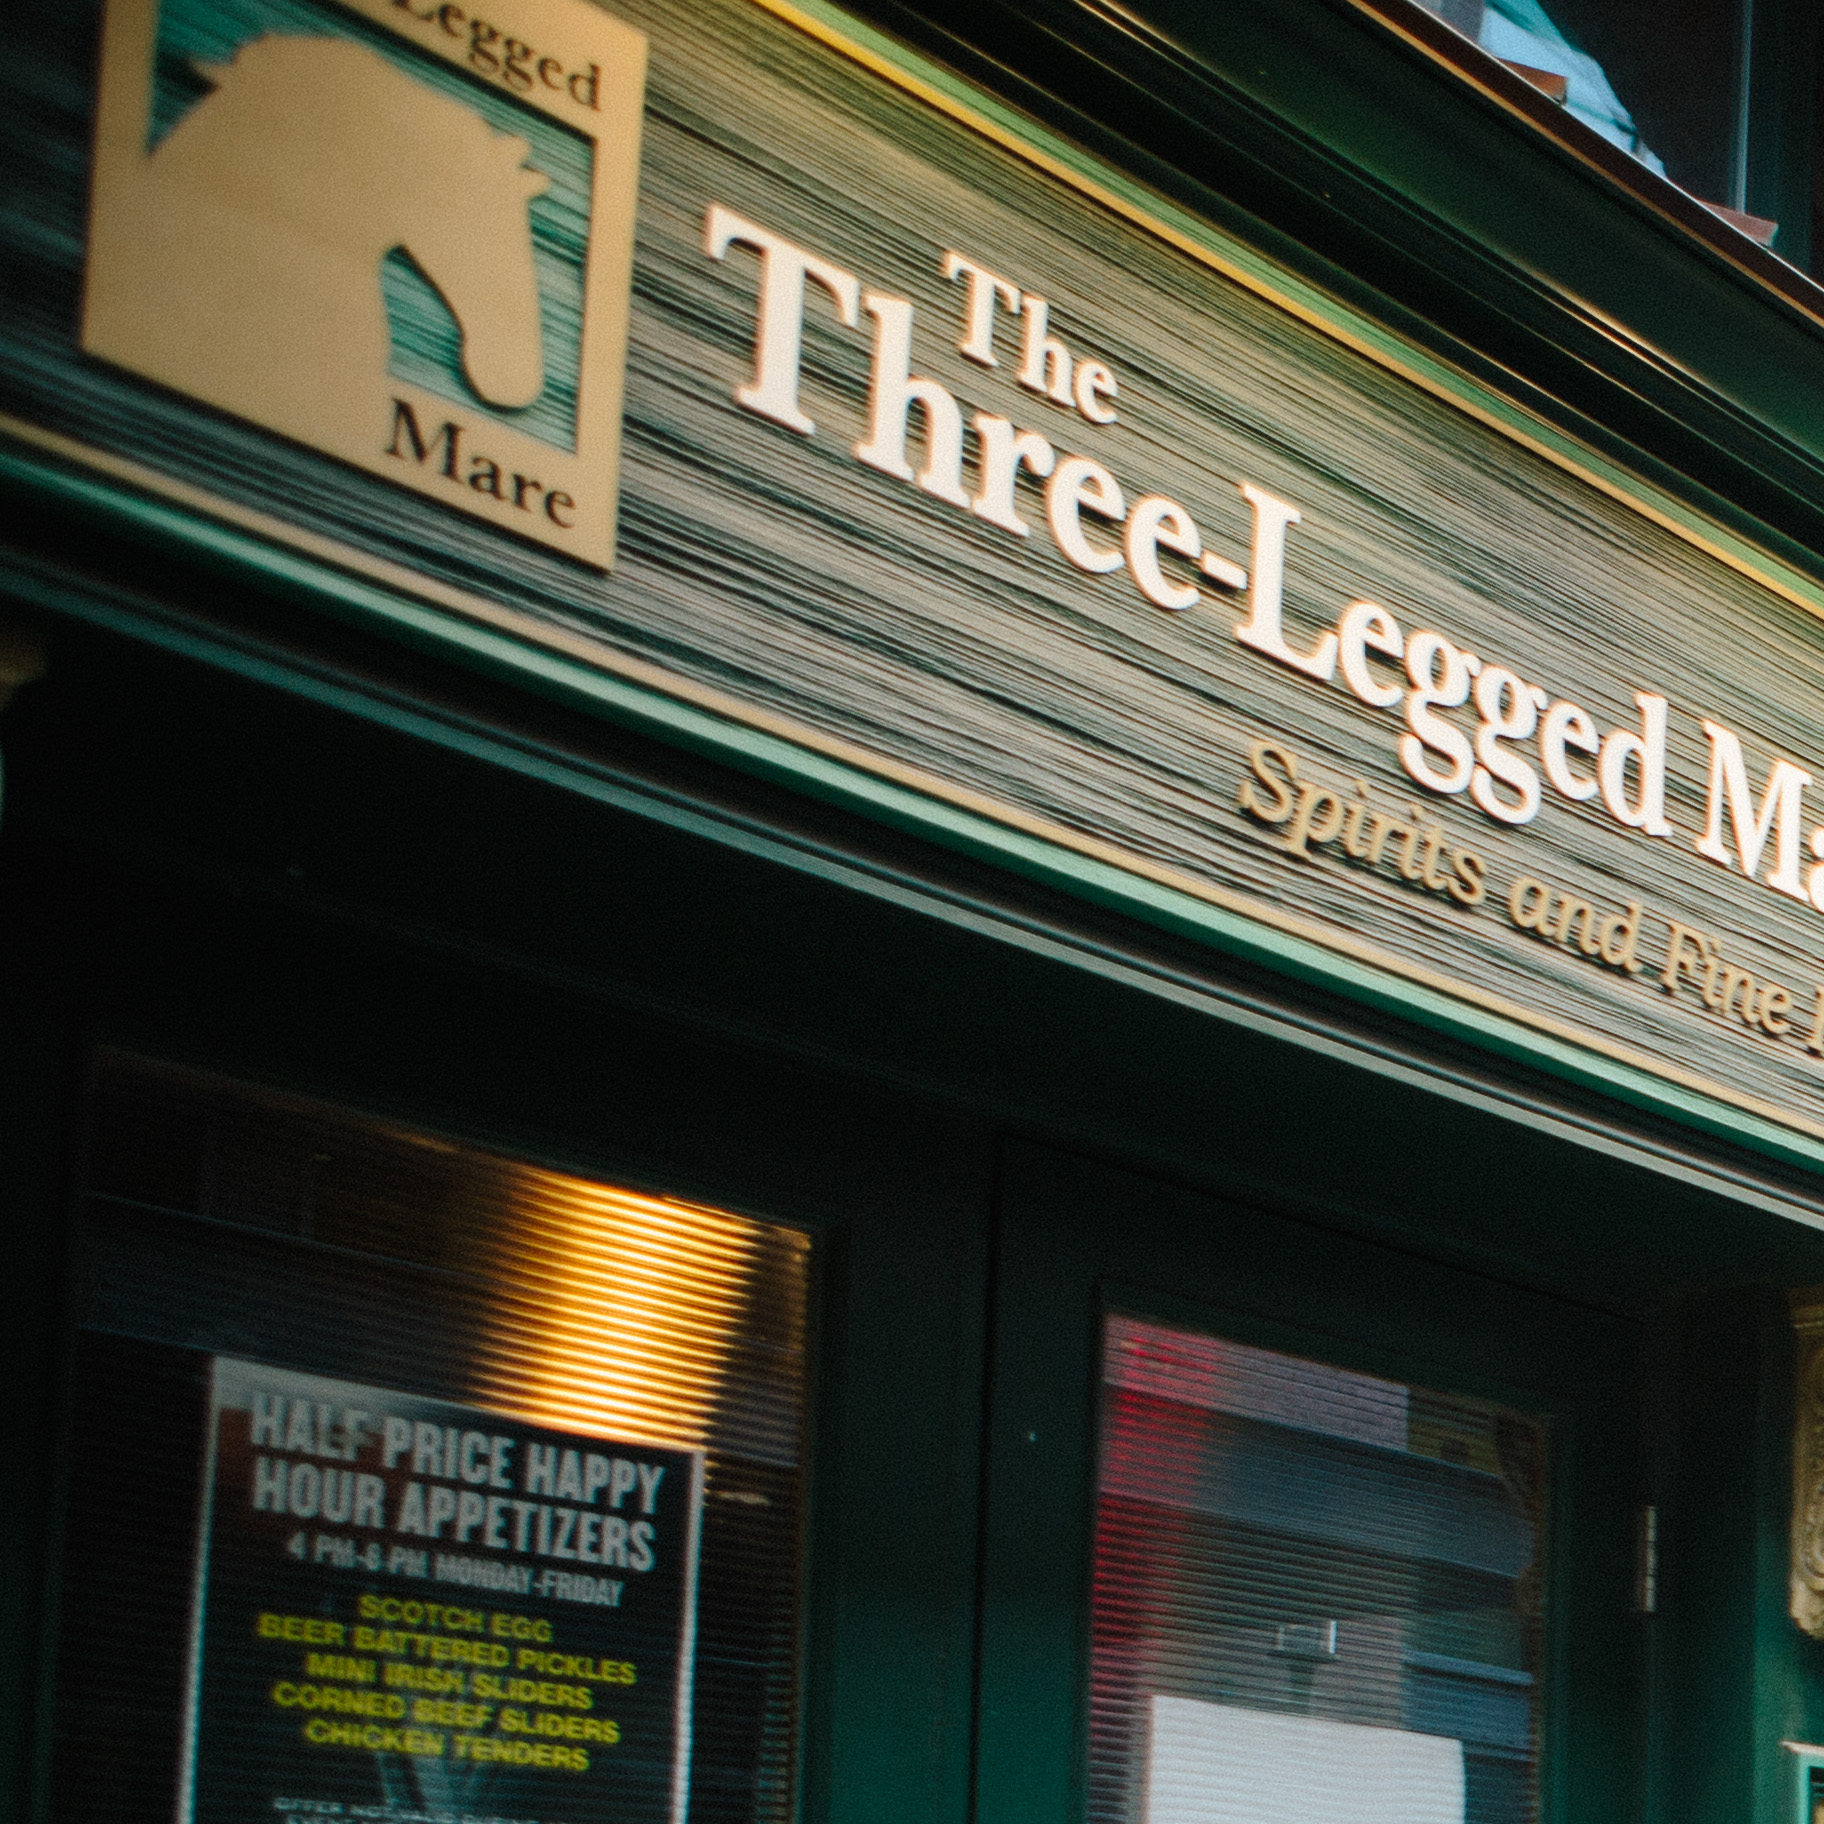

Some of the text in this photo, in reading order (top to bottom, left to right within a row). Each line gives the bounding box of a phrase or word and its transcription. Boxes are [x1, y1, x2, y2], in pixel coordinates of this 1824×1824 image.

[942, 250, 1119, 424] The
[383, 397, 577, 529] Mare
[703, 202, 1675, 826] Three-Legged
[1239, 740, 1490, 907] Spirits
[1509, 877, 1645, 974] and
[1662, 922, 1794, 1040] Fine
[251, 1393, 666, 1514] HALF PRICE HAPPY
[252, 1457, 658, 1573] HOUR APPETIZERS
[287, 1532, 307, 1559] 4
[257, 1612, 638, 1686] BEER BATTERED PICKLES
[357, 1594, 554, 1644] SCOTCH EGG
[271, 1681, 621, 1744] CORNED BEEF SLIDERS
[305, 1653, 594, 1710] MINI IRISH SLIDERS
[304, 1718, 590, 1772] CHICKEN TENDERS
